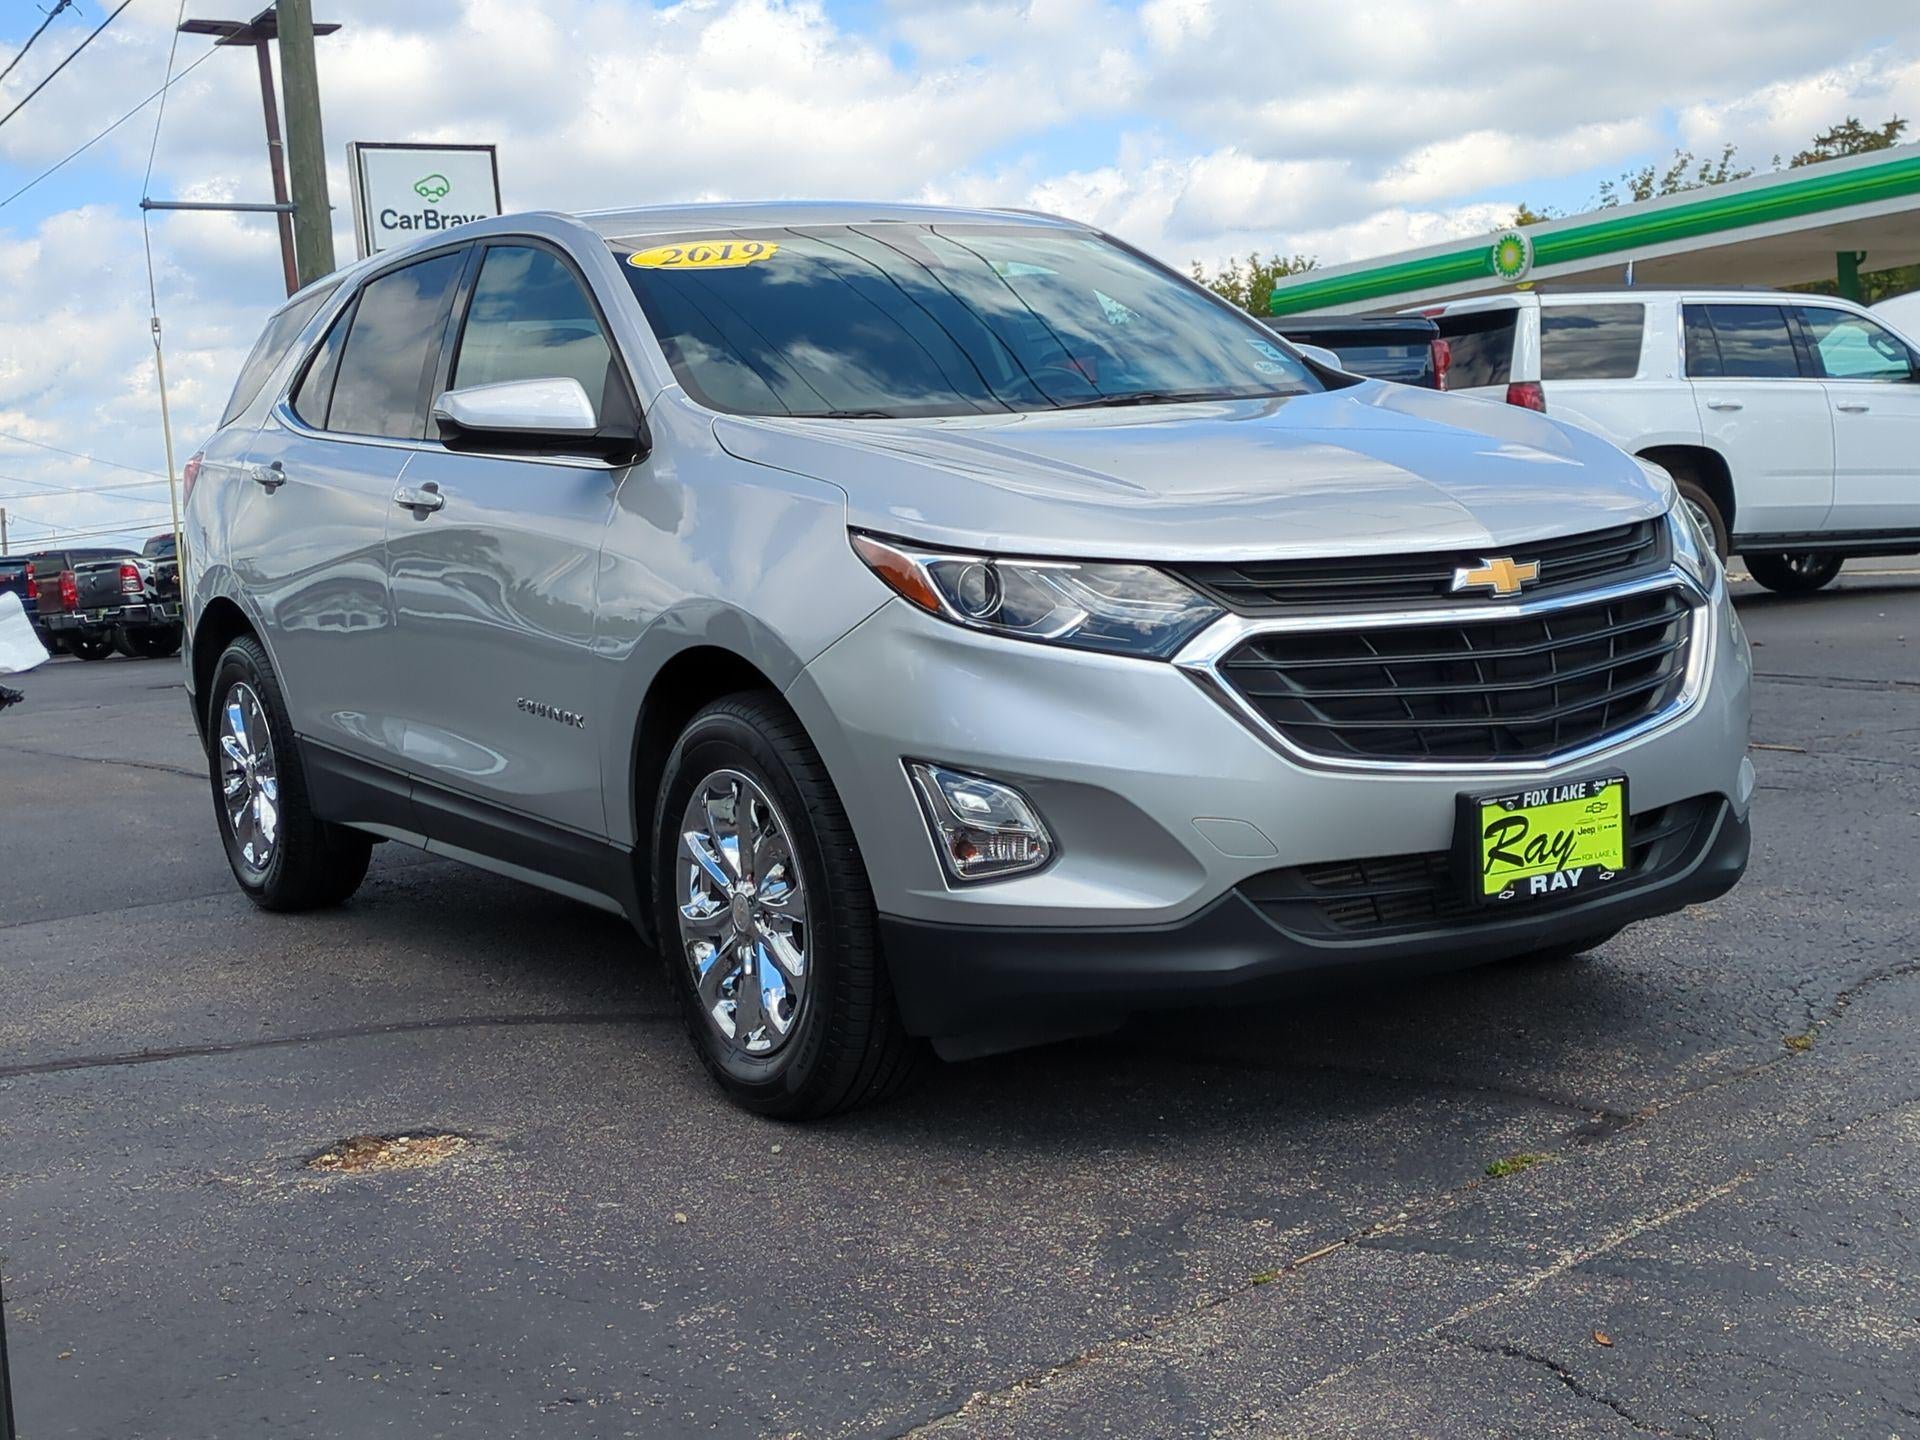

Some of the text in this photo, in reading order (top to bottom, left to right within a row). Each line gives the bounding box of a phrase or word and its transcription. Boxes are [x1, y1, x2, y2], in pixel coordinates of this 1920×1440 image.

[659, 242, 765, 265] 2019
[1523, 782, 1586, 808] FOX LAKE
[1577, 826, 1596, 836] Jeep
[1483, 815, 1577, 875] Ray
[1530, 868, 1583, 895] RAY
